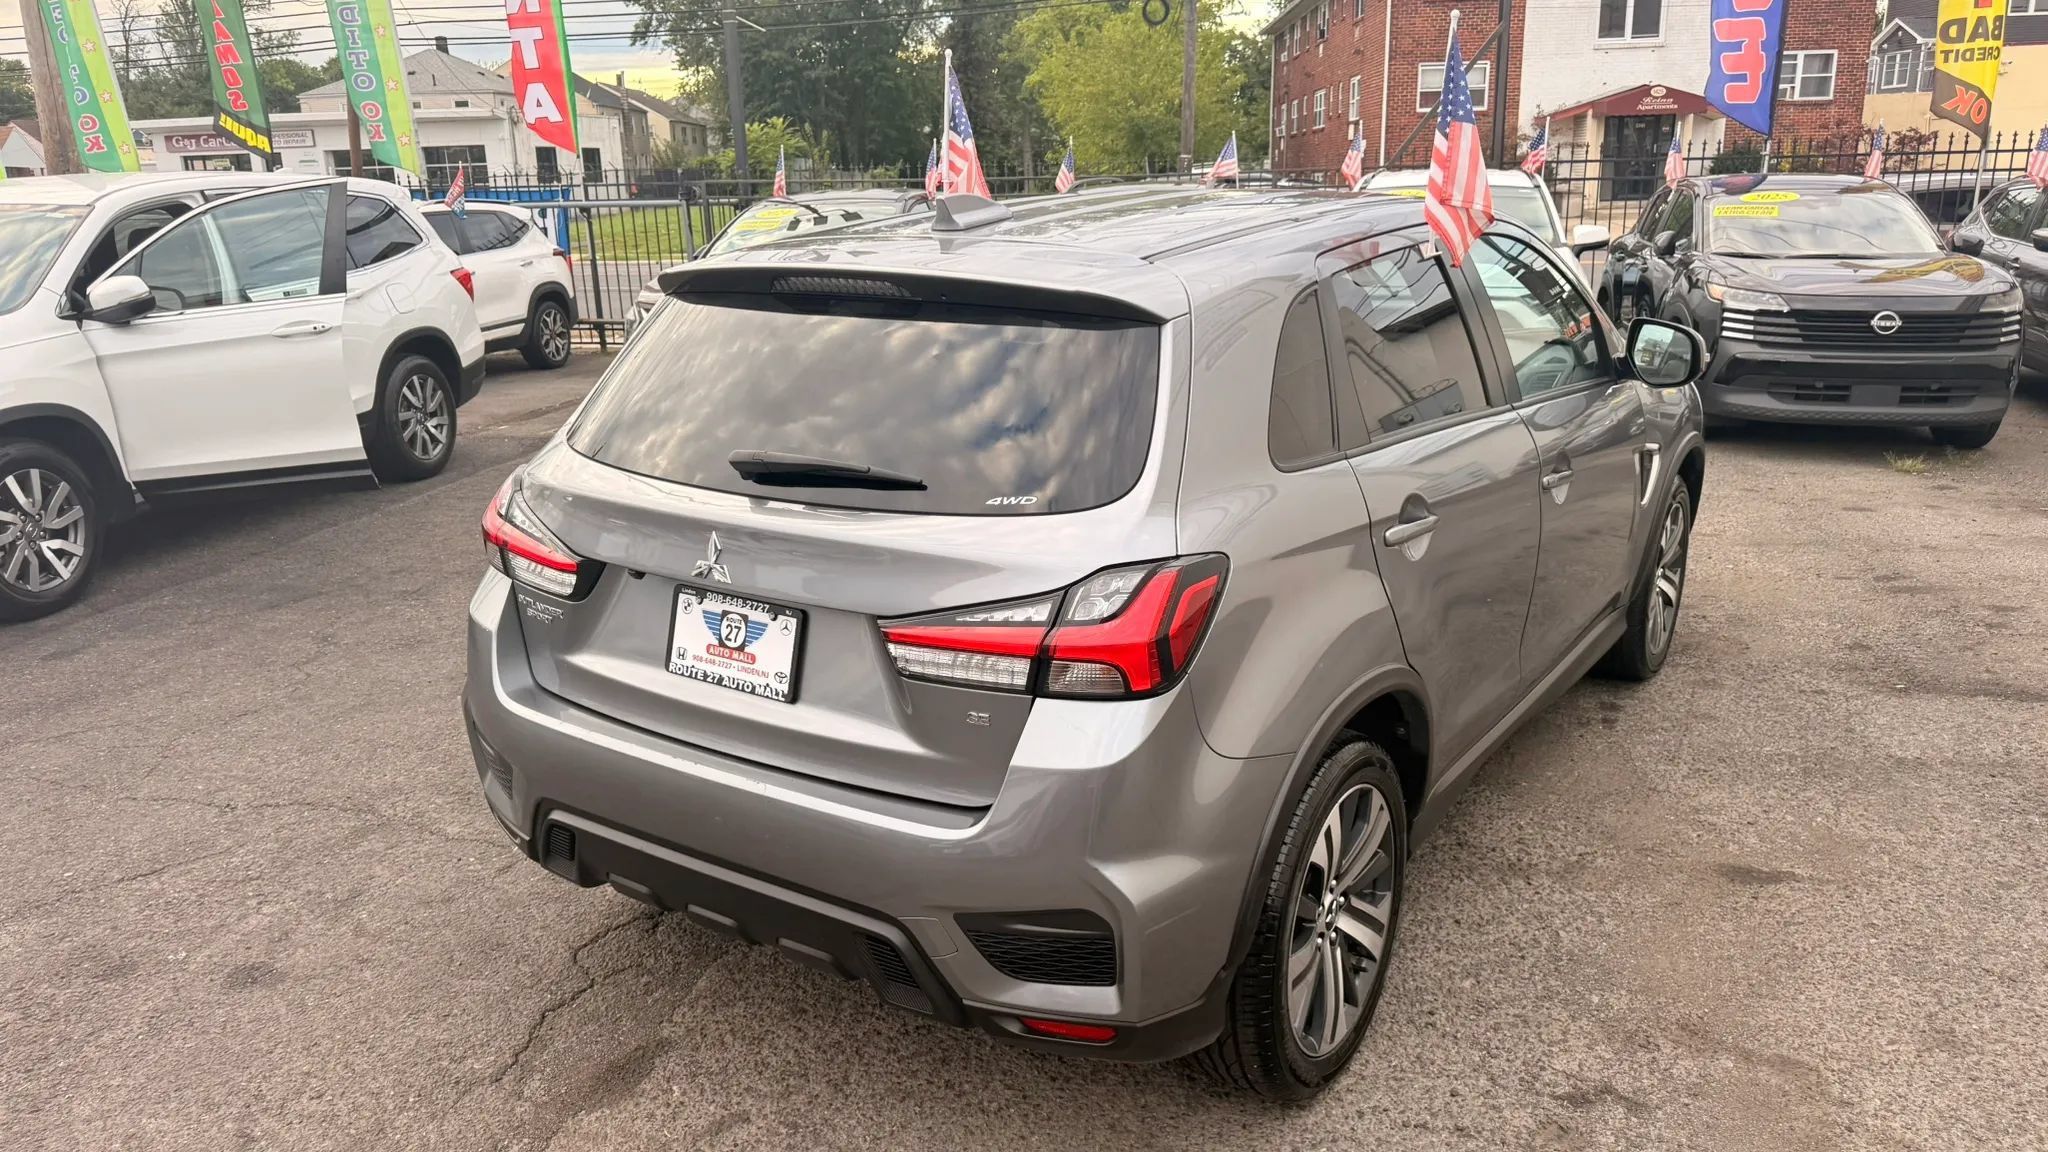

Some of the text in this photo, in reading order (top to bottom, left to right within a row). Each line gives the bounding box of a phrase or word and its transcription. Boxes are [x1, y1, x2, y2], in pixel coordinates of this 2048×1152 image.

[172, 137, 197, 150] G&J
[985, 496, 1038, 506] 4WD
[706, 592, 770, 614] 908-648-2727
[726, 616, 743, 626] ROUTE
[724, 623, 742, 643] 27
[692, 654, 732, 669] 908-648-2727
[709, 646, 753, 663] AUTO MALL
[669, 662, 786, 701] ROUTE 27 AUTO MALL
